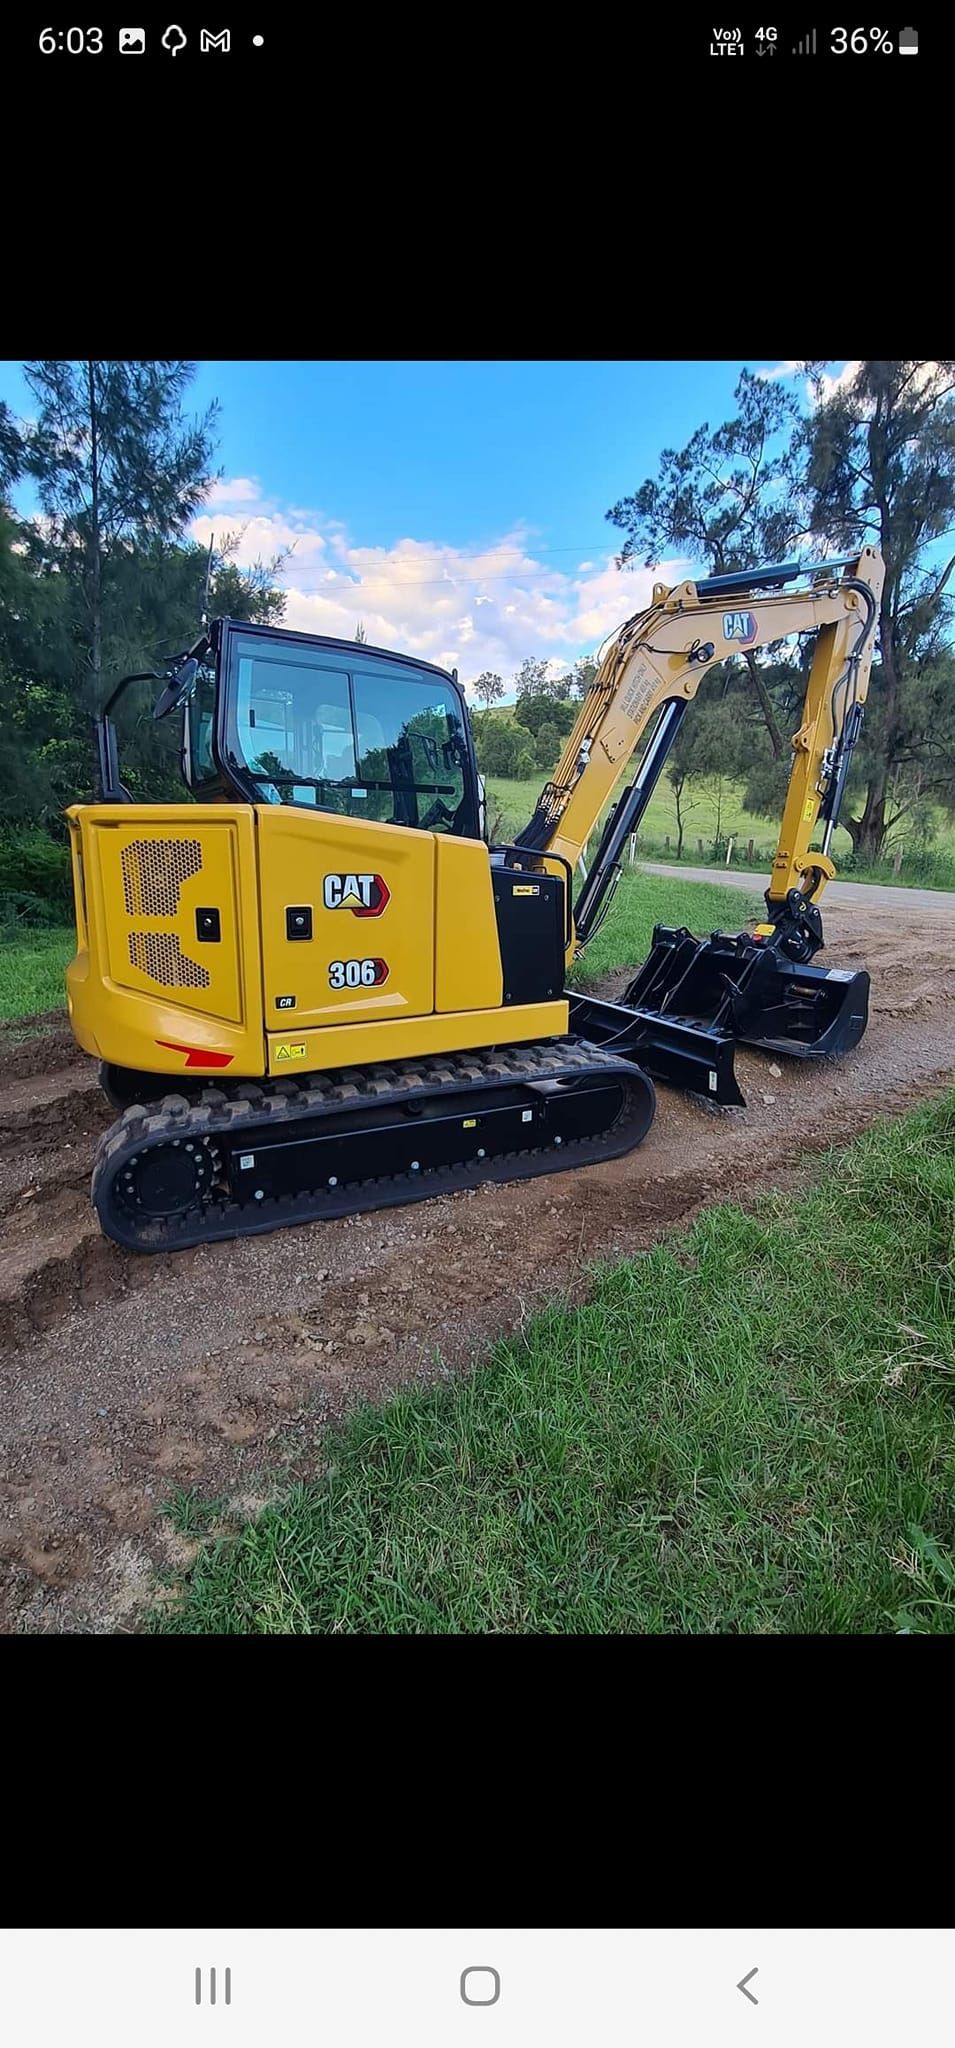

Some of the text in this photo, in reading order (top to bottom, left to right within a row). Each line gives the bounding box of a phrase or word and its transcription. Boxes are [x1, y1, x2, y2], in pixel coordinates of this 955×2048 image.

[723, 612, 750, 640] CAT
[324, 875, 375, 909] CAT
[330, 960, 376, 988] 306
[279, 997, 293, 1008] CR
